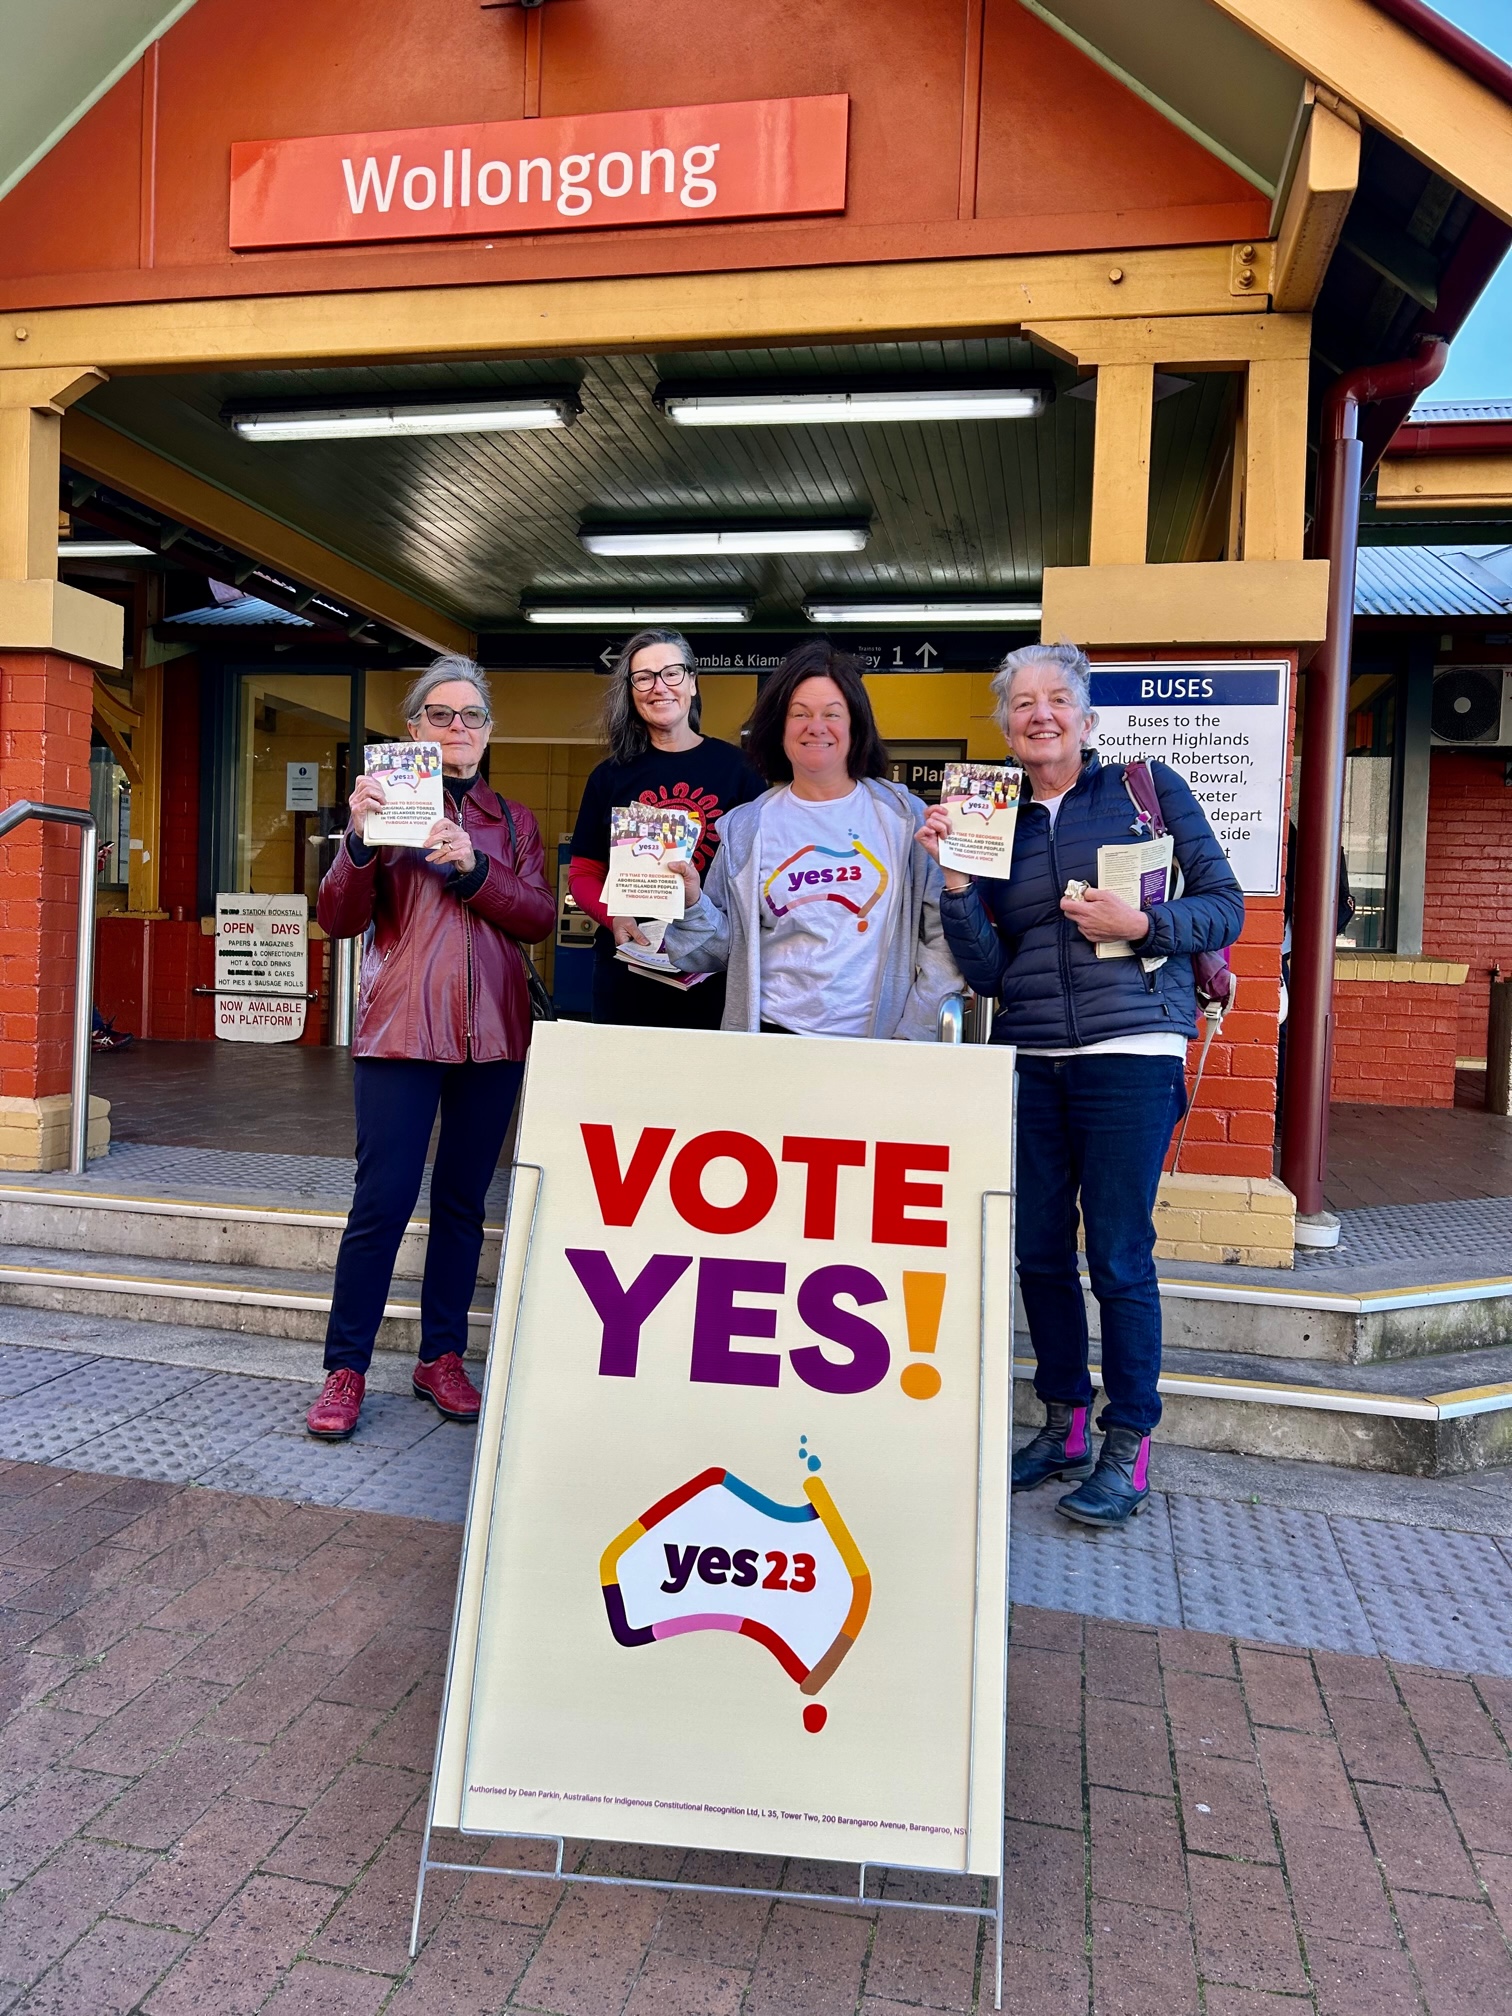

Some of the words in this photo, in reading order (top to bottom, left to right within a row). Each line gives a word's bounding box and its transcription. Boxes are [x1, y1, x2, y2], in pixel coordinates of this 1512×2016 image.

[342, 143, 720, 216] Wollongong
[694, 654, 731, 666] embla
[734, 654, 744, 666] &
[892, 646, 903, 665] 1
[1141, 678, 1213, 698] BUSES
[1128, 715, 1169, 727] Buses
[1174, 716, 1189, 727] to
[1195, 714, 1220, 727] the
[1098, 734, 1166, 746] Southern
[1173, 733, 1249, 748] Highlands
[1171, 752, 1254, 767] Robertson,
[1190, 771, 1248, 786] Bowral,
[968, 801, 989, 809] yes23
[1211, 808, 1262, 824] depart
[1220, 827, 1251, 840] side
[638, 843, 659, 851] yes23
[787, 866, 862, 892] yes23
[223, 922, 254, 934] OPEN
[271, 923, 300, 935] DAYS
[220, 1000, 243, 1011] NOW
[248, 1002, 302, 1013] AVAILABLE
[220, 1014, 235, 1024] ON
[239, 1014, 293, 1026] PLATFORM
[297, 1016, 302, 1027] 1
[580, 1123, 950, 1248] VOTE
[564, 1248, 947, 1400] YES!
[659, 1543, 817, 1594] yes23
[469, 1784, 507, 1795] Authorised
[508, 1788, 517, 1797] by
[519, 1788, 536, 1797] Dean
[538, 1790, 562, 1801] Parkin,
[563, 1792, 601, 1803] Australians
[603, 1795, 613, 1804] for
[614, 1796, 652, 1807] Indigenous
[654, 1799, 702, 1811] Constitutional
[704, 1804, 745, 1815] Recognition
[746, 1807, 760, 1818] Ltd,
[761, 1809, 766, 1817] L
[767, 1810, 779, 1819] 35,
[780, 1811, 801, 1820] Tower
[803, 1813, 821, 1823] Two,
[822, 1815, 836, 1824] 200
[837, 1816, 878, 1828] Barangaroo
[879, 1820, 908, 1831] Avenue,
[909, 1823, 952, 1836] Barangaroo,
